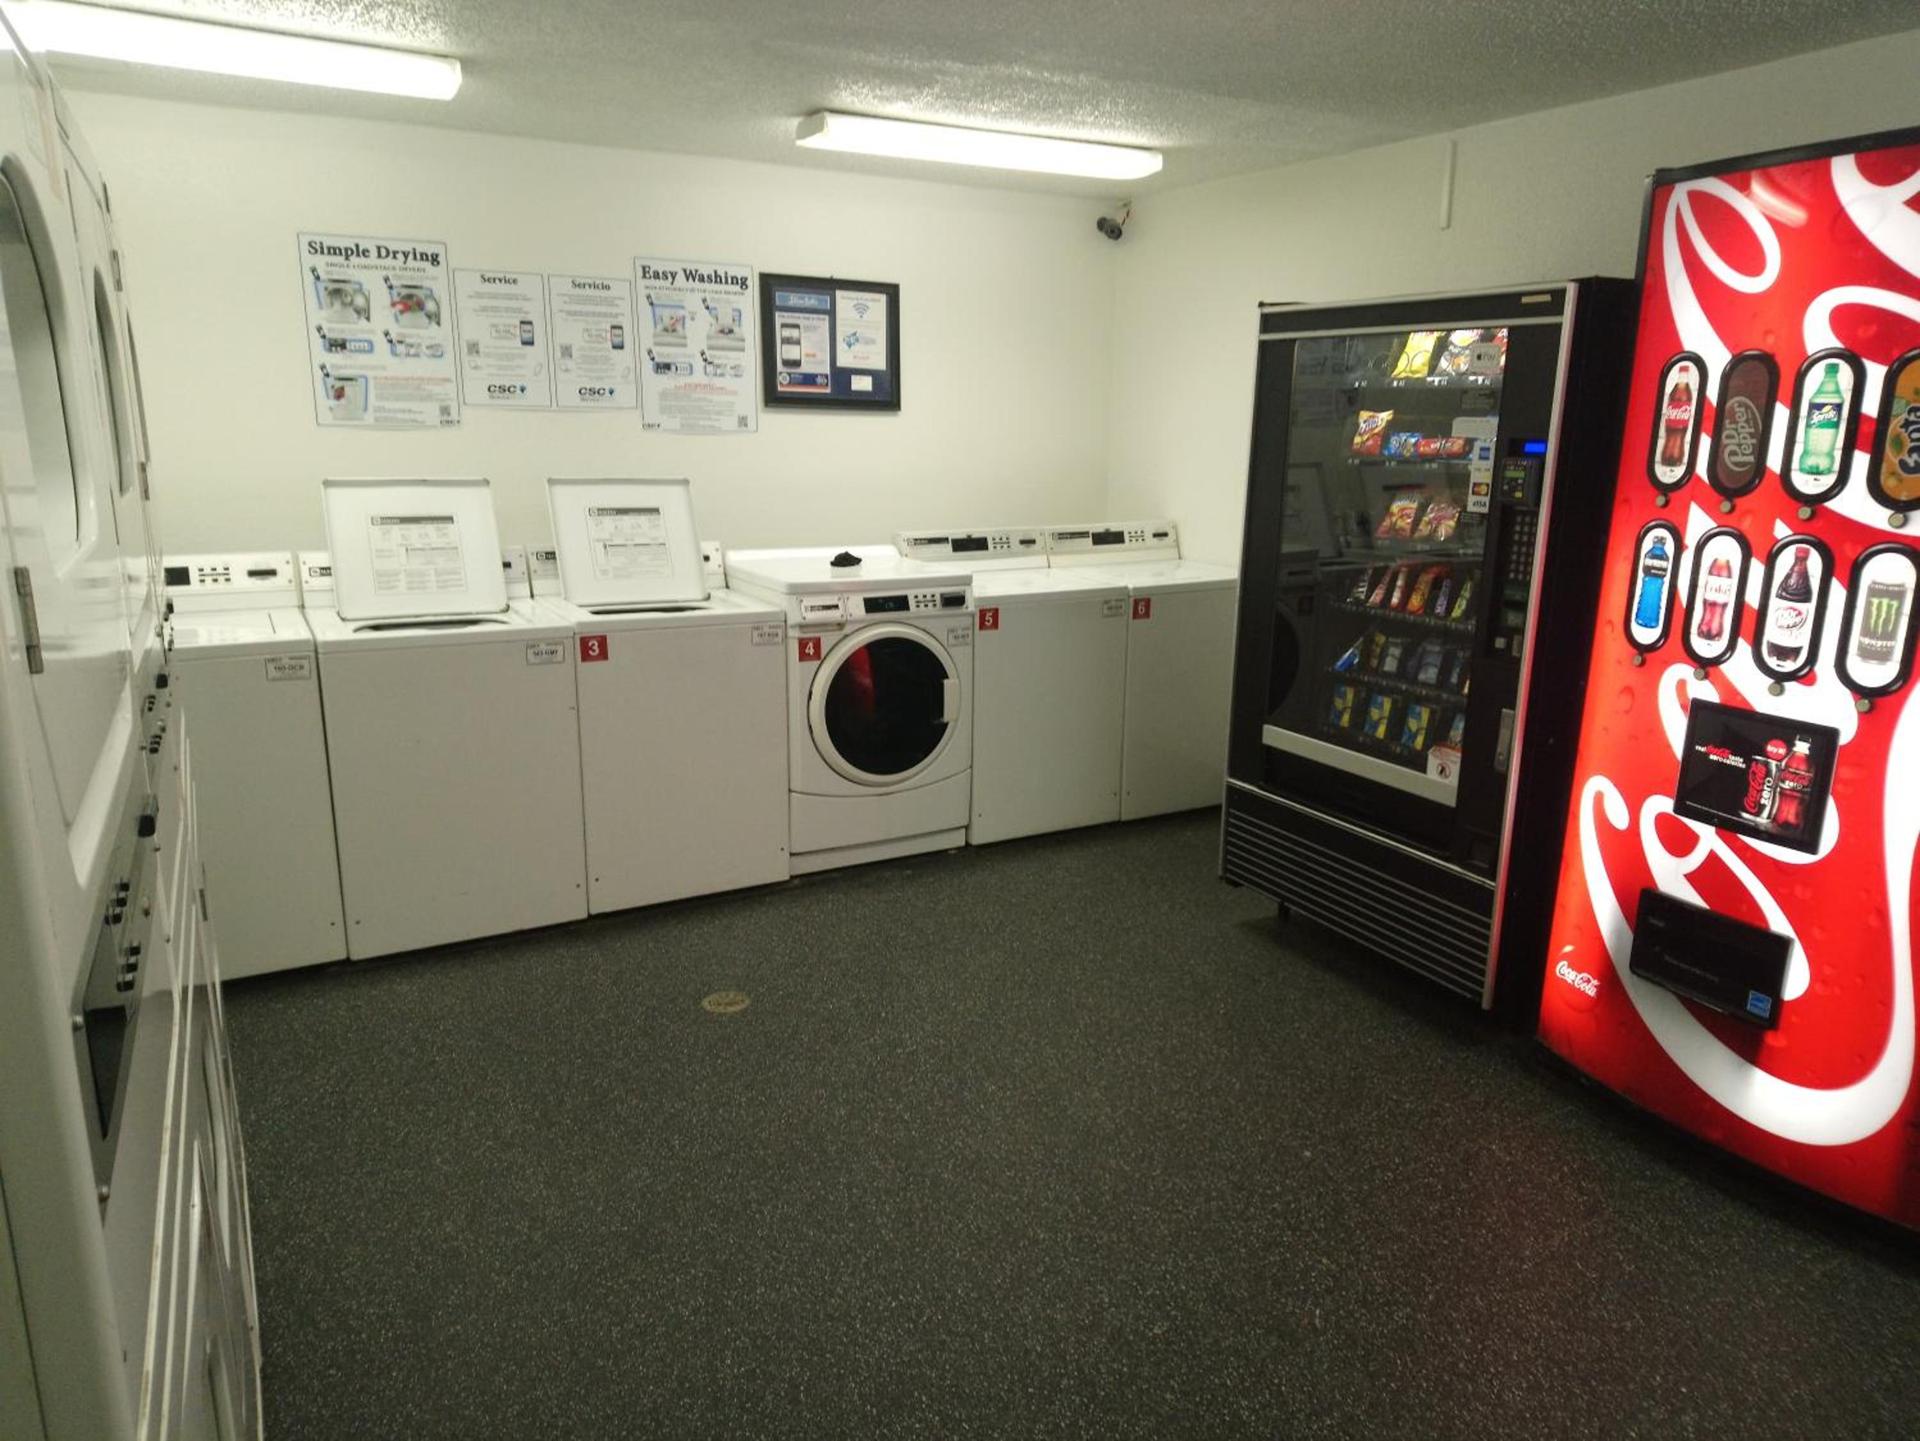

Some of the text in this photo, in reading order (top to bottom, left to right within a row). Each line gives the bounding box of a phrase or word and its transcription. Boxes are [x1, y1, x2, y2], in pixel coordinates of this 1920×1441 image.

[307, 240, 441, 267] Simple Drying
[480, 273, 519, 285] Service
[571, 279, 612, 291] Servicio
[641, 264, 749, 291] Easy Washing
[487, 384, 518, 395] CSC
[578, 387, 606, 397] CSC
[1810, 408, 1839, 427] Sprite
[1722, 419, 1740, 445] Dr
[1724, 403, 1757, 463] Pepper
[1138, 603, 1146, 615] 6
[984, 612, 993, 626] 5
[588, 640, 600, 657] 3
[804, 641, 815, 656] 4
[1760, 776, 1774, 806] zero
[1784, 779, 1803, 790] zero
[1555, 960, 1601, 998] Coca-Cola
